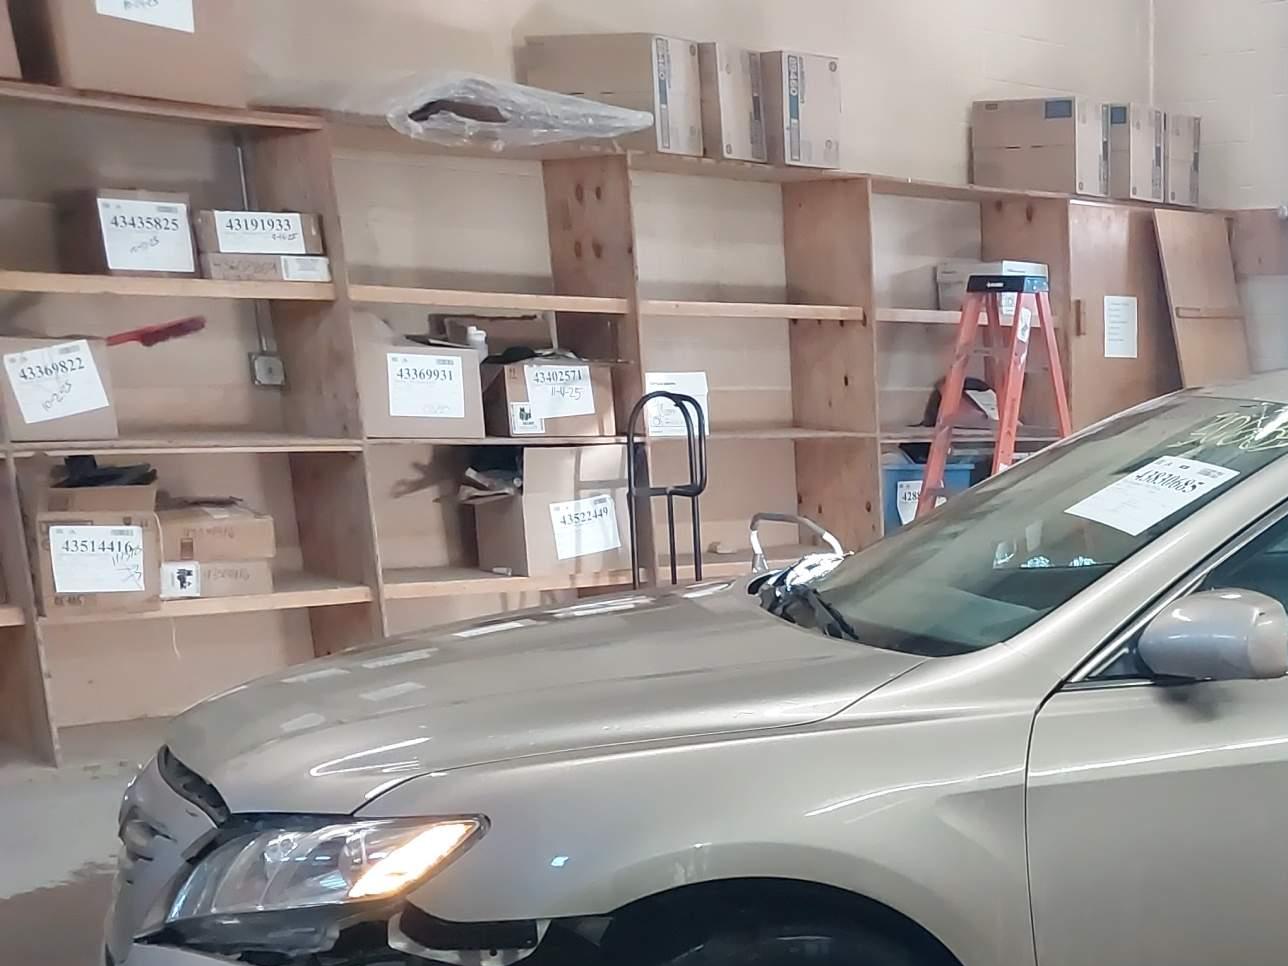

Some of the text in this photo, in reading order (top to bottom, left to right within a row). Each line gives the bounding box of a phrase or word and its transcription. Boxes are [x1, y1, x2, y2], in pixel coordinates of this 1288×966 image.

[109, 214, 180, 232] 43435825
[225, 217, 292, 232] 43191933
[20, 357, 85, 380] 43369822
[396, 367, 453, 382] 43369931
[533, 369, 582, 384] 43402571
[1135, 470, 1205, 493] 43830685
[560, 506, 609, 526] 43522449
[61, 540, 133, 554] 43514416
